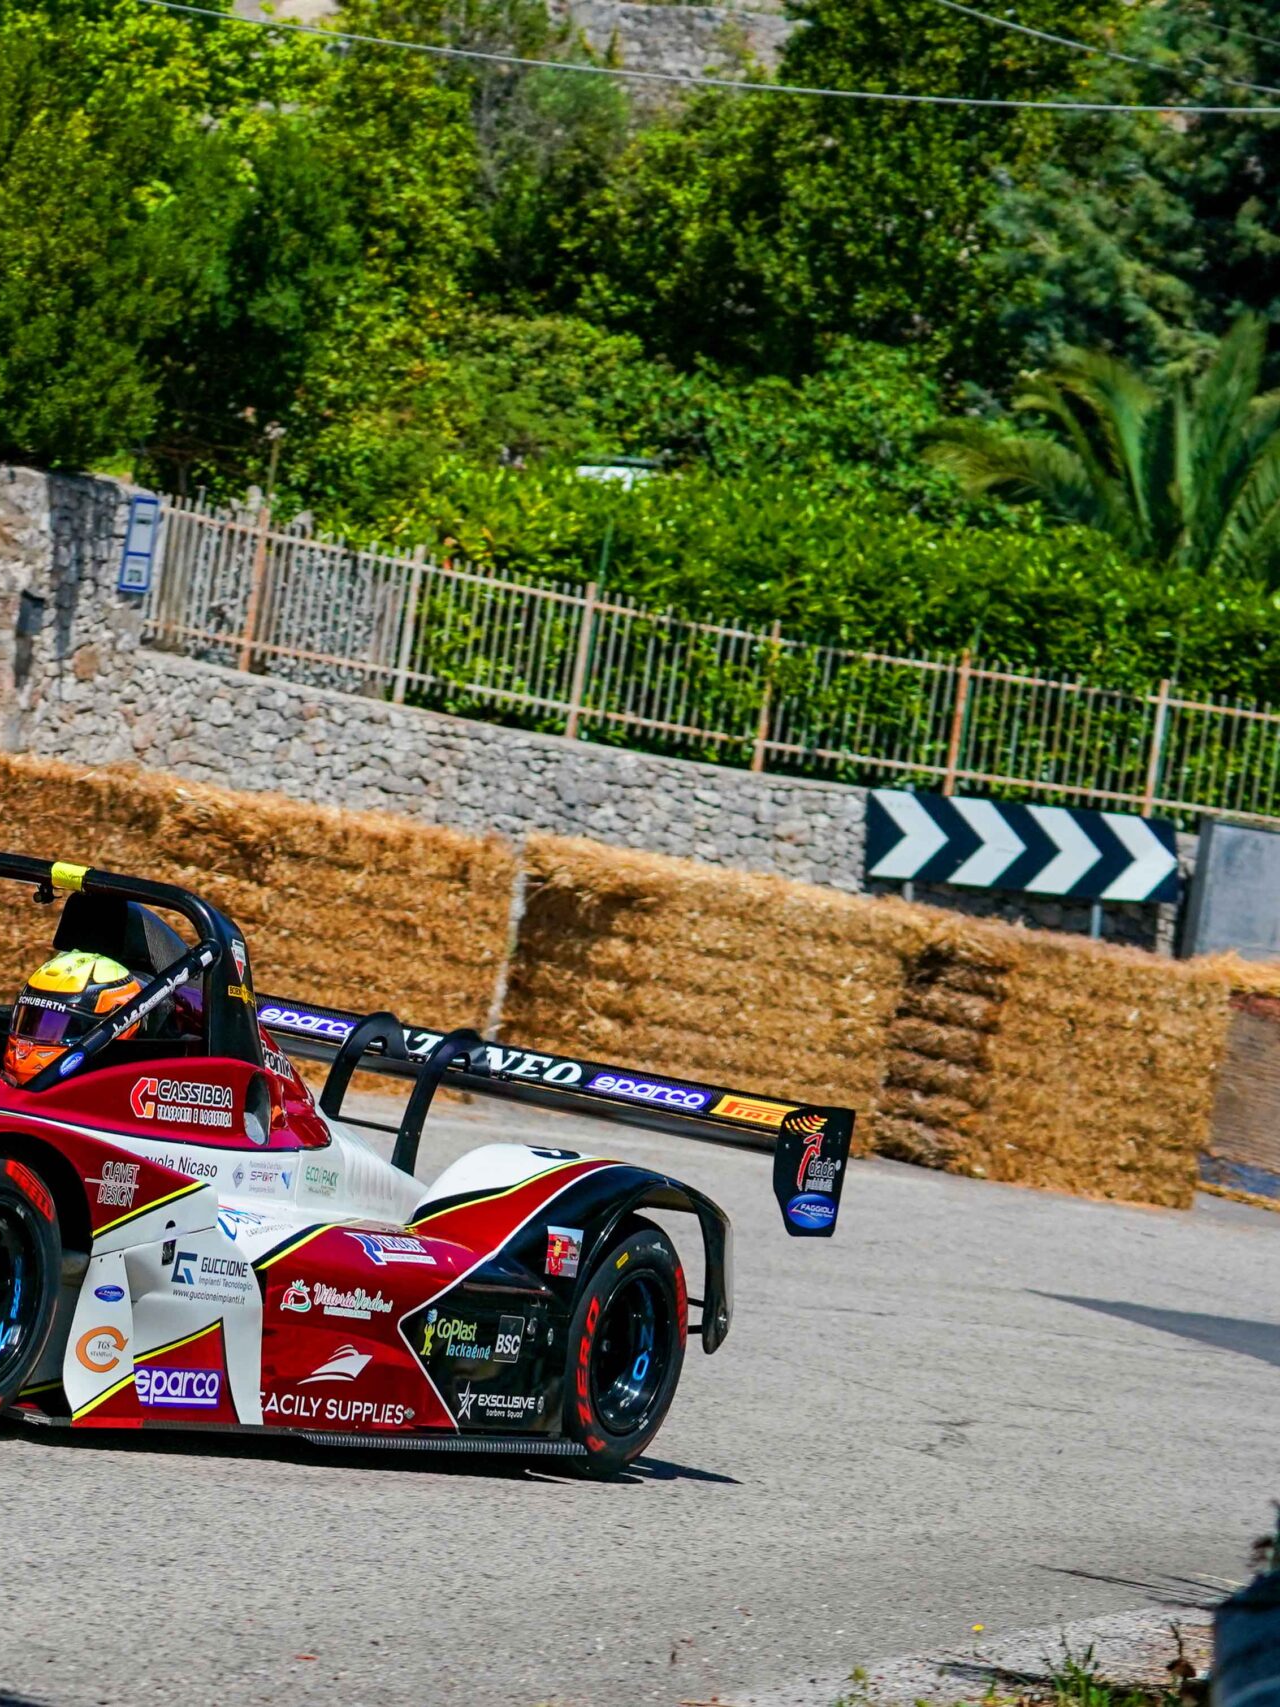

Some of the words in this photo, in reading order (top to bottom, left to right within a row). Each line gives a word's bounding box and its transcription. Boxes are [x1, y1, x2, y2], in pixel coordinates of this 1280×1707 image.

[18, 995, 67, 1013] SCHUBERTH
[157, 1080, 233, 1107] CASSIBBA
[593, 1075, 705, 1110] sparco
[157, 1105, 192, 1123] TRASPORTI
[200, 1110, 233, 1127] LOGISTICA
[724, 1101, 784, 1123] PIRE
[178, 1156, 218, 1178] Nicaso
[250, 1170, 279, 1182] SPORT
[97, 1183, 133, 1208] DESIGN
[800, 1203, 835, 1214] FAGGIOLI
[201, 1257, 248, 1277] GUCCIONE
[199, 1276, 221, 1288] Impianti
[97, 1341, 110, 1350] TGS
[495, 1334, 520, 1354] BSC
[135, 1370, 219, 1405] sparco
[325, 1398, 405, 1425] SUPPLIES
[478, 1394, 536, 1409] EXSCLUSIVE
